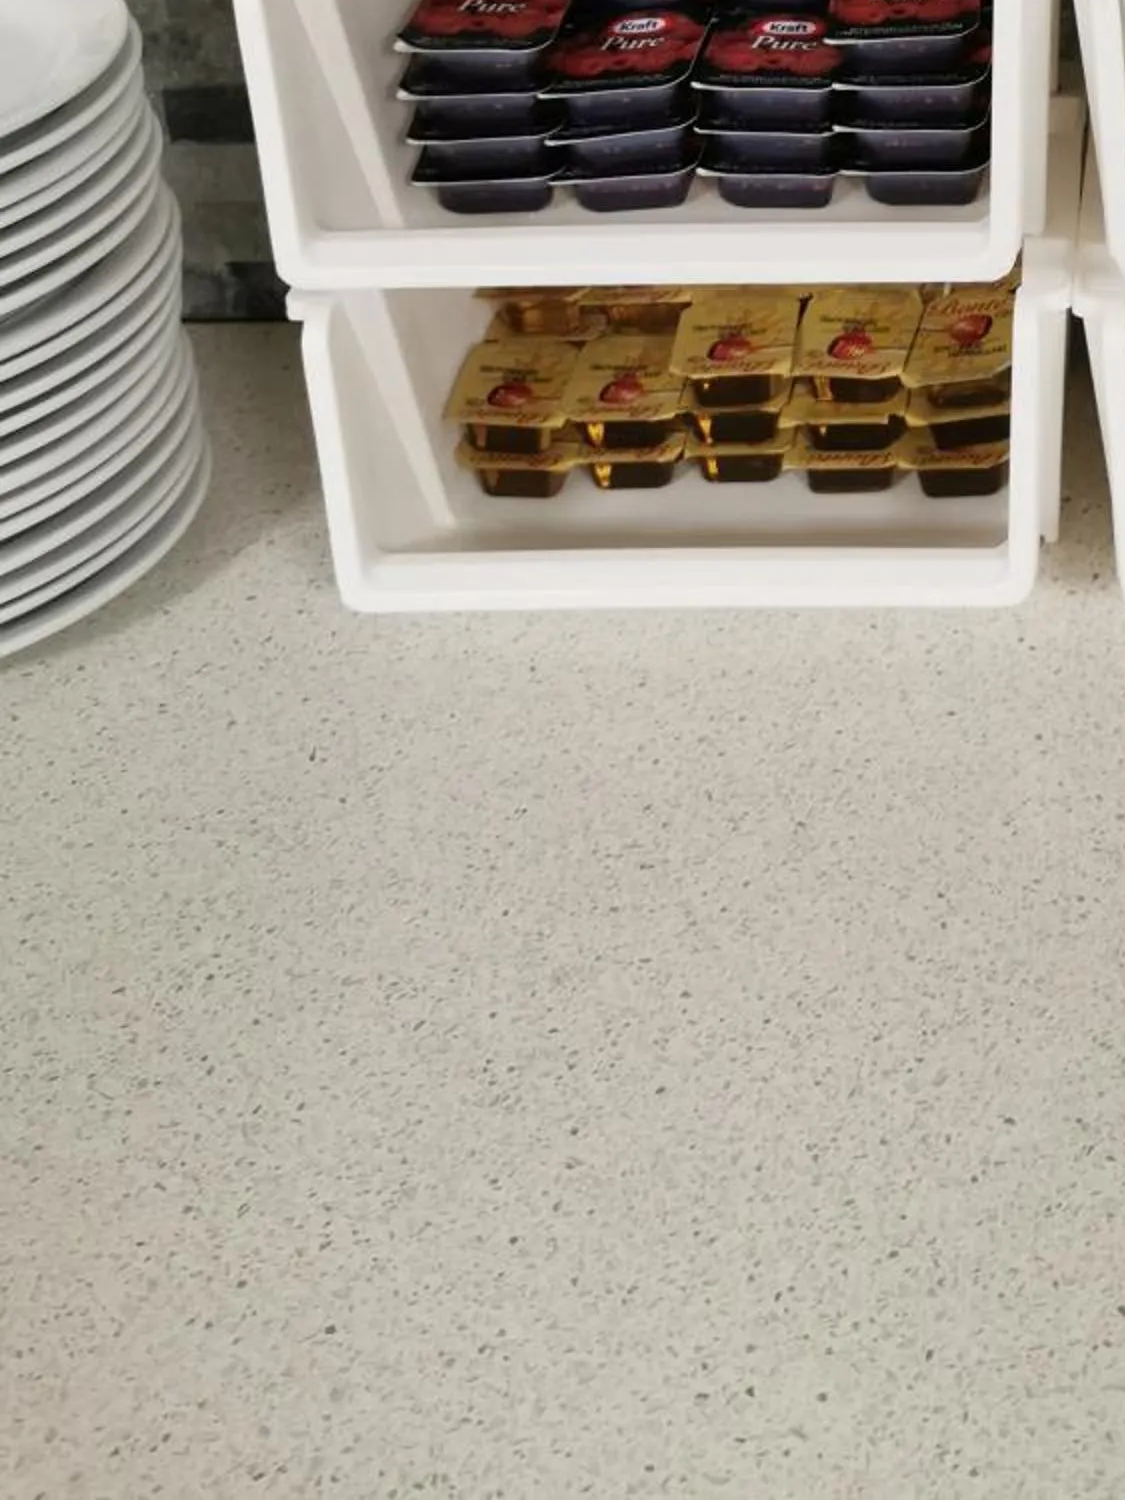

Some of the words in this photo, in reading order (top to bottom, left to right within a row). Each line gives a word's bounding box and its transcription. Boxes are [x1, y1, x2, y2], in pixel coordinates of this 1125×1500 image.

[619, 19, 659, 31] Kraft
[769, 22, 809, 33] Kraft
[601, 35, 665, 50] Pure
[751, 35, 817, 51] Pure
